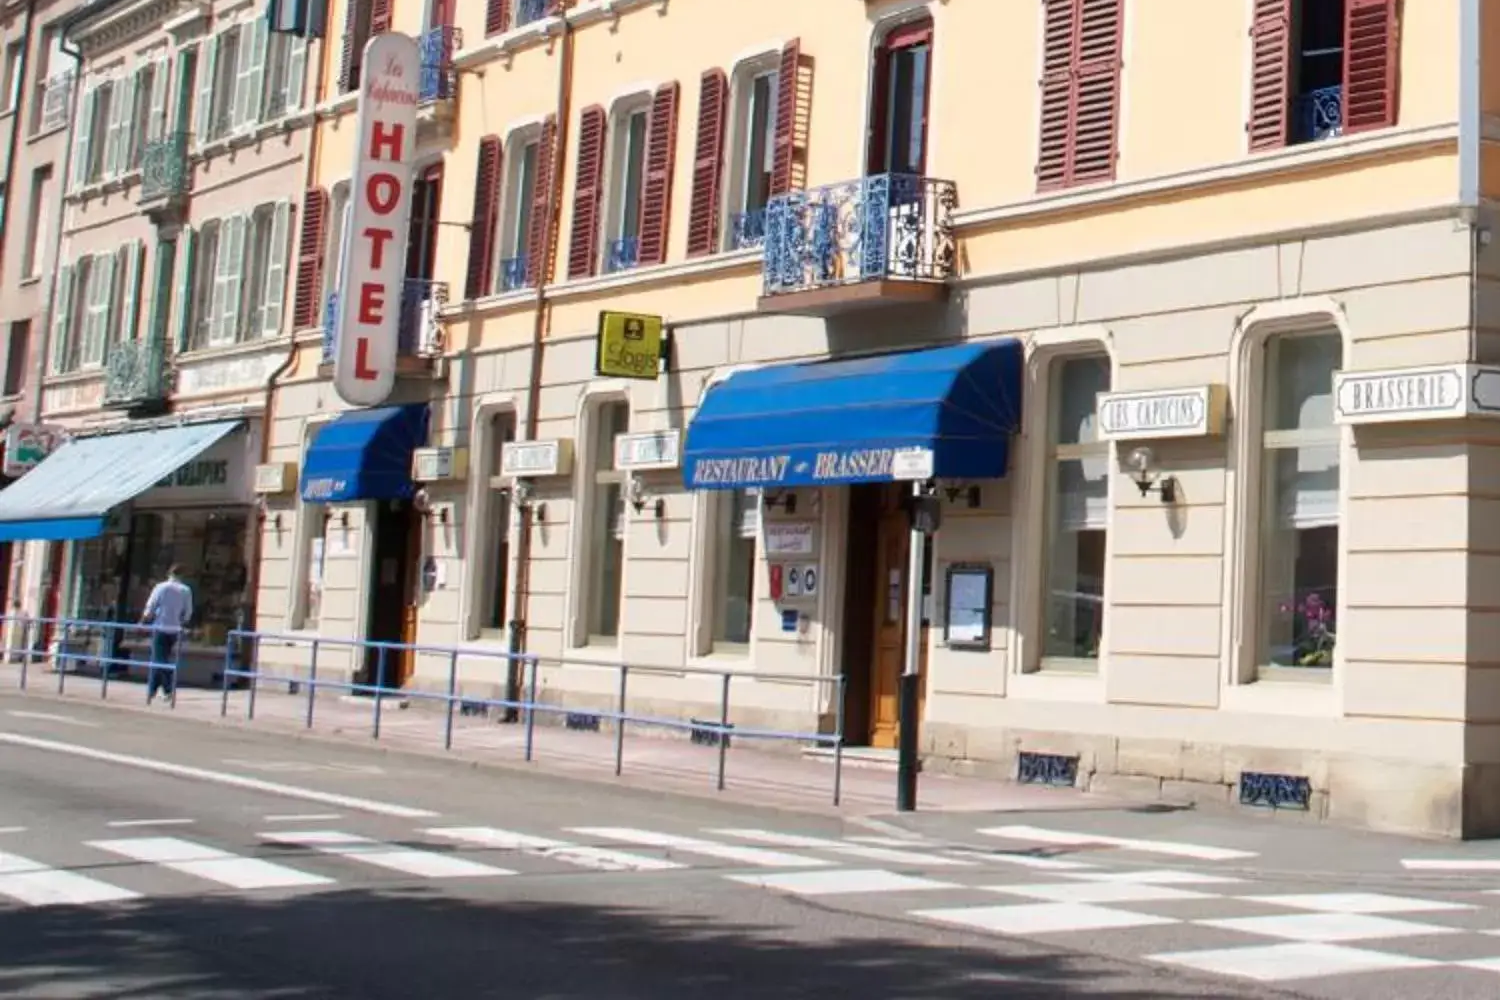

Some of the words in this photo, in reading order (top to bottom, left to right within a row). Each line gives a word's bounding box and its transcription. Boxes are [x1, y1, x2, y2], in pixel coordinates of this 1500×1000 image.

[353, 119, 404, 381] HOTEL
[605, 341, 658, 375] Logis
[1352, 375, 1447, 411] BRASSERIE
[1109, 401, 1129, 428] LES
[1136, 396, 1196, 426] CAPUCINS
[693, 455, 791, 484] RESTAURANT
[812, 447, 905, 480] BRASSER
